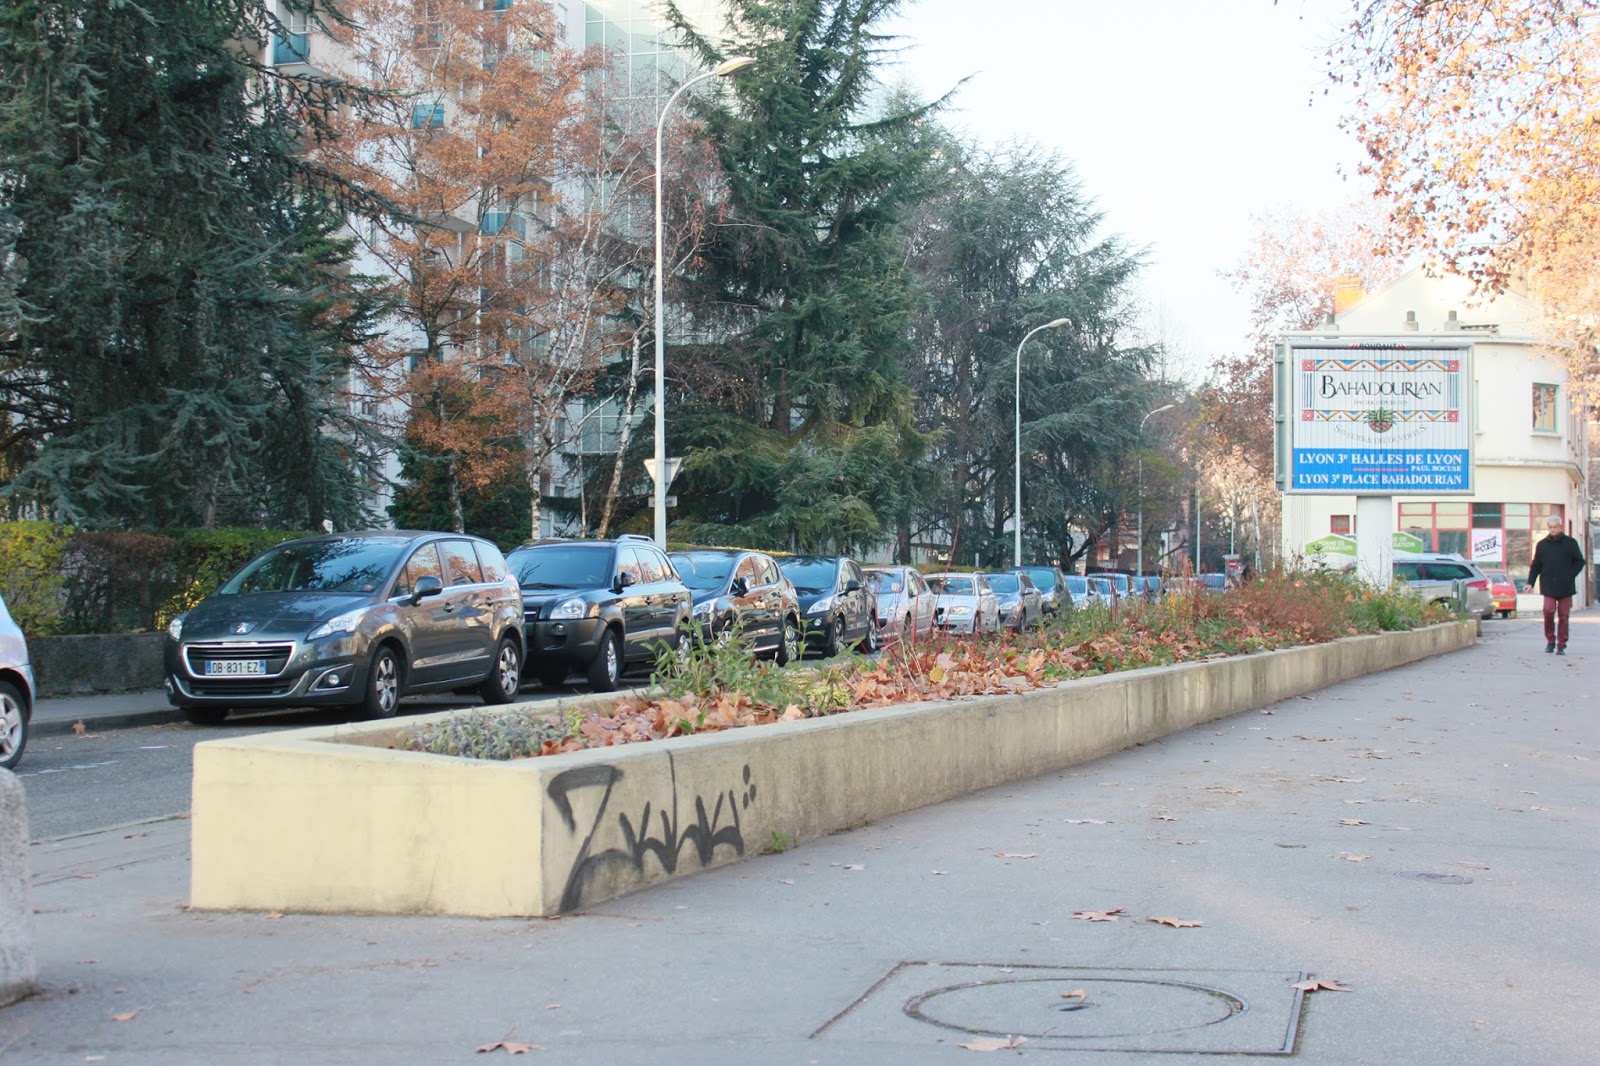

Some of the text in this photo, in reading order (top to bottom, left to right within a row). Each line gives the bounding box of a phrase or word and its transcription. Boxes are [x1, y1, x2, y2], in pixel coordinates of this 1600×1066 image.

[1319, 375, 1442, 399] BAHADOURIAN
[1299, 453, 1334, 464] LYON
[1351, 454, 1403, 464] HALLES
[1405, 454, 1423, 464] DE
[1427, 454, 1462, 465] LYON
[1299, 474, 1329, 484] LYON
[1342, 475, 1379, 484] PLACE
[1381, 474, 1462, 485] BAHADOURIAN
